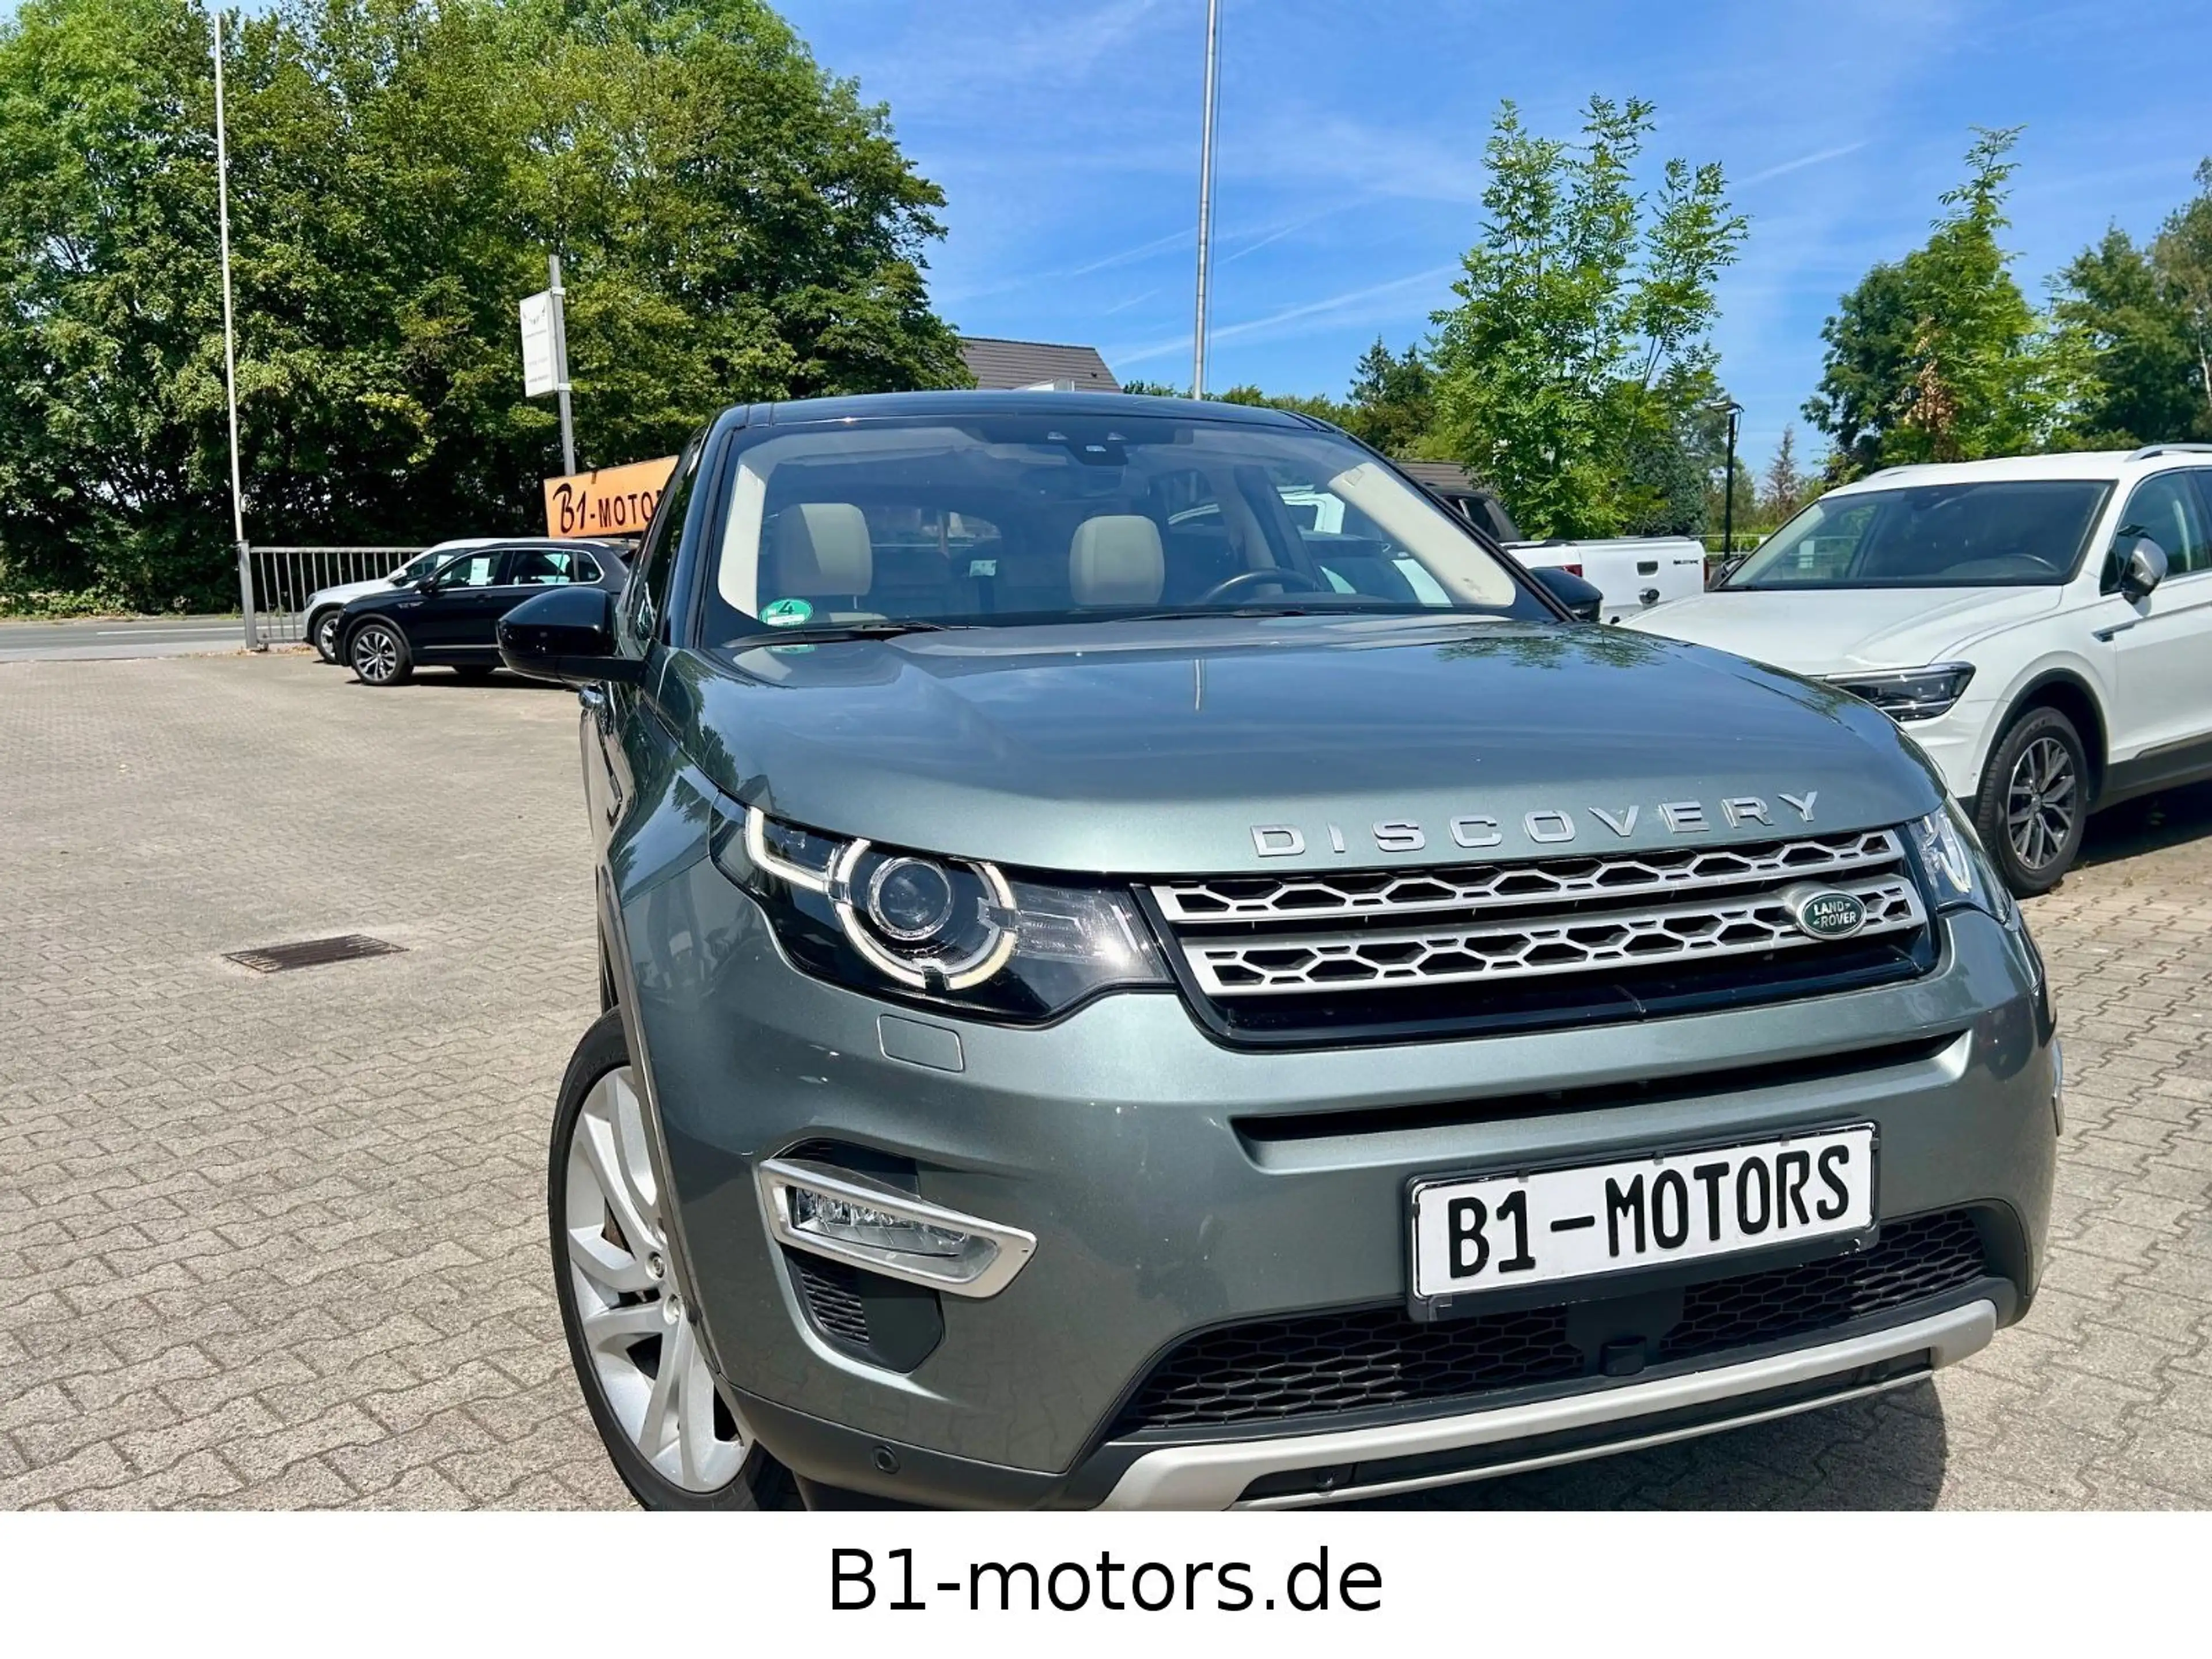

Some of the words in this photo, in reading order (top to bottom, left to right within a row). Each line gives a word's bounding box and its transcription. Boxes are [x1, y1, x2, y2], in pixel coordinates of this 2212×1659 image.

[778, 601, 794, 615] 4
[1249, 791, 1818, 857] DISCOVERY
[1813, 901, 1844, 916] LAND
[1820, 911, 1857, 929] ROVER
[1448, 1144, 1850, 1279] B1-MOTORS
